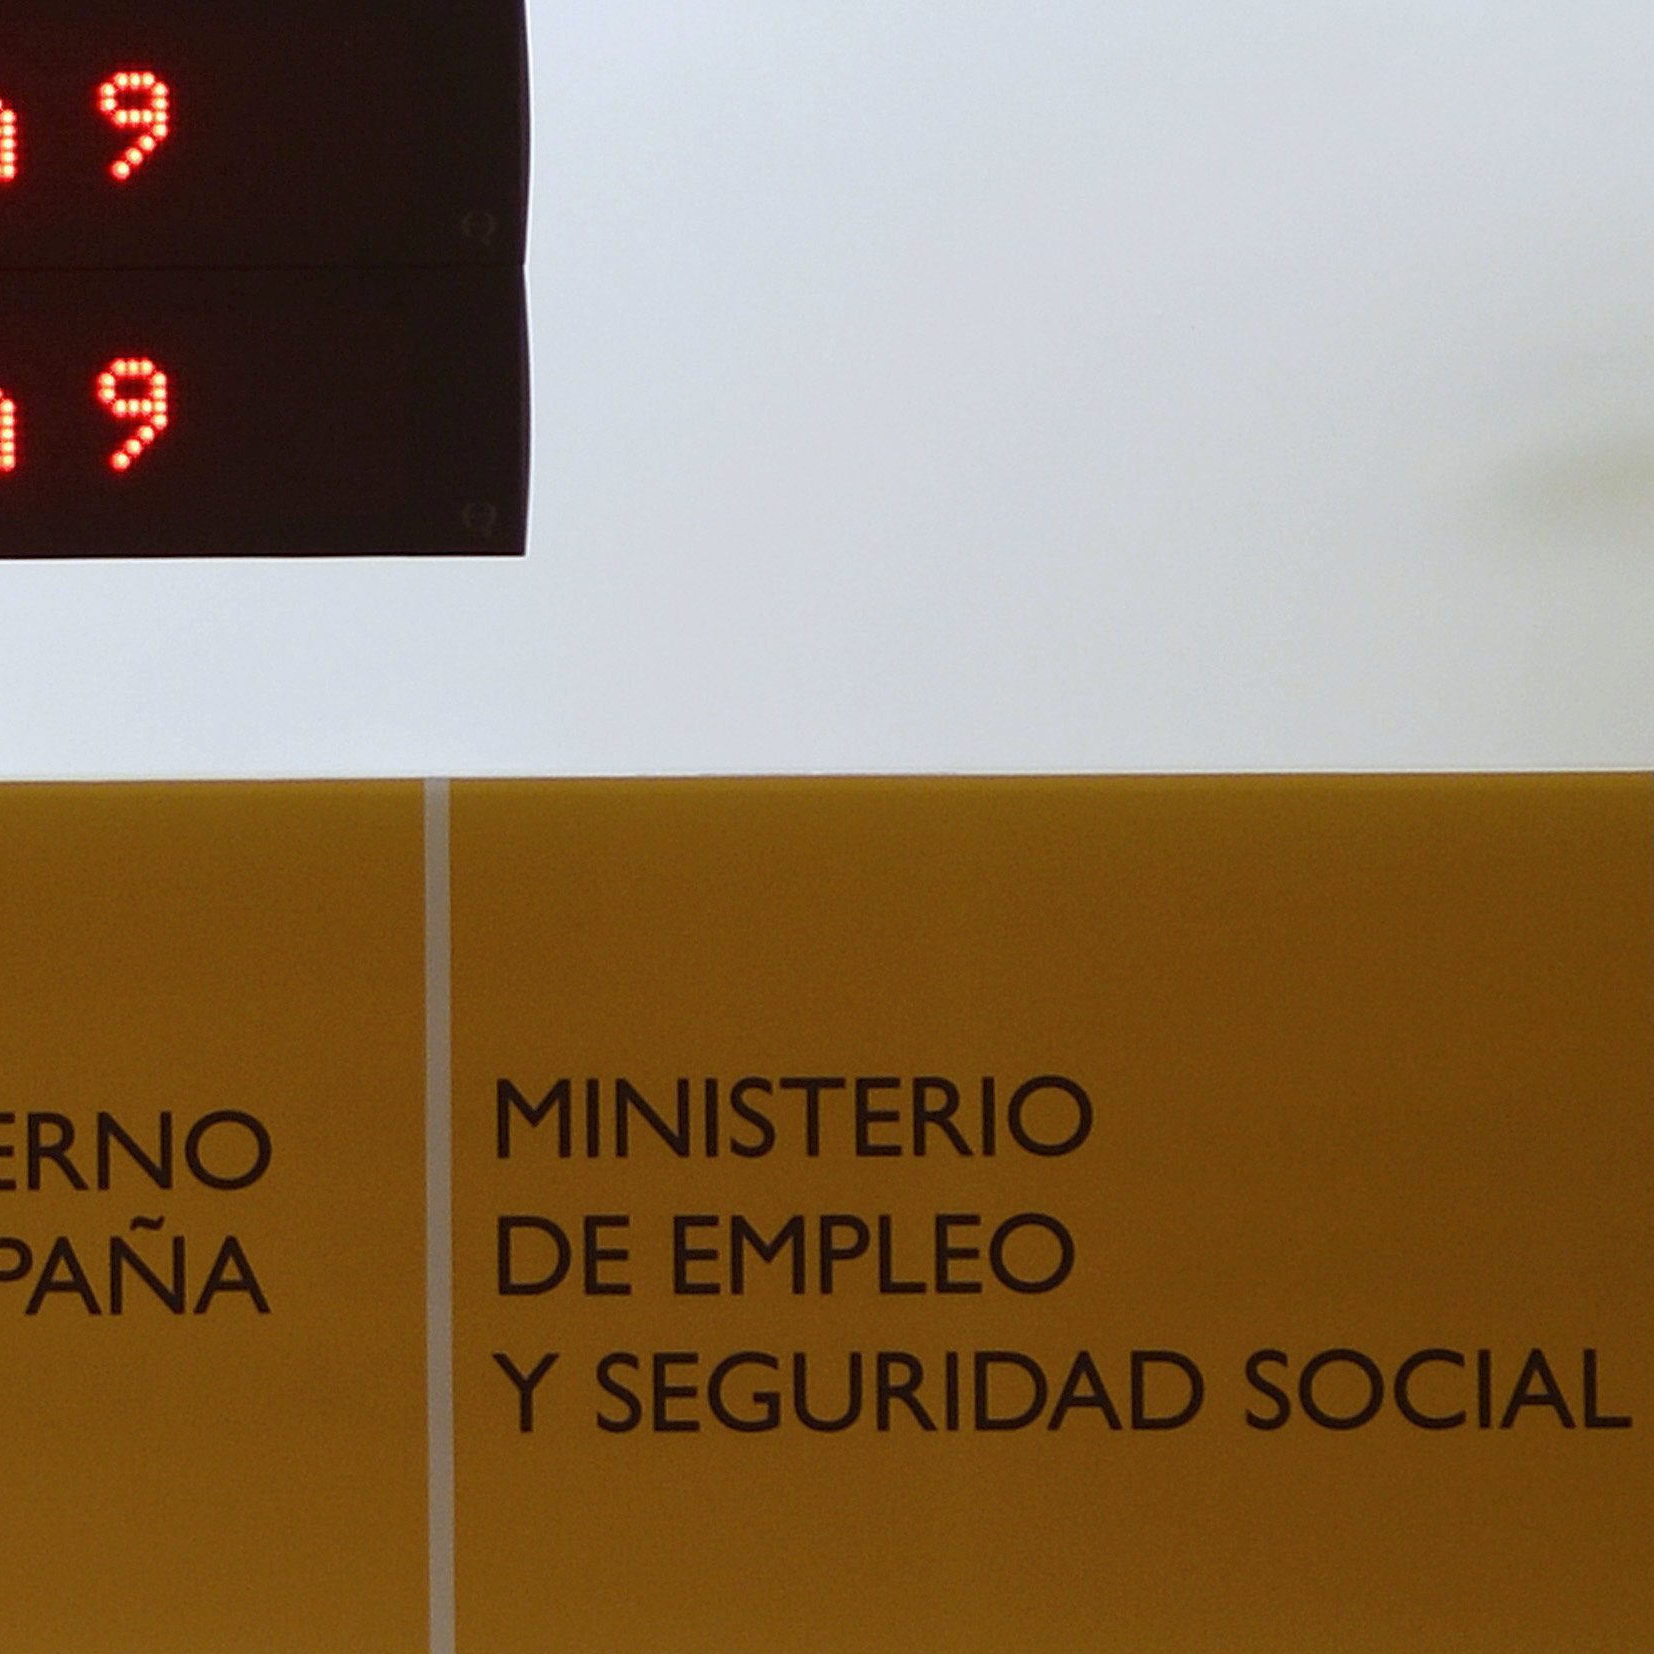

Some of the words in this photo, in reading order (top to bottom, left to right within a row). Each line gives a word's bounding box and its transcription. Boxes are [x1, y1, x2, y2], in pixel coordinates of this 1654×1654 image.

[97, 71, 170, 181] 9
[96, 357, 168, 471] 9
[497, 1076, 1092, 1158] MINISTERIO
[498, 1216, 631, 1295] DE
[674, 1213, 1074, 1295] EMPLEO
[493, 1354, 558, 1433] Y
[597, 1351, 1204, 1433] SEGURIDAD
[1246, 1349, 1632, 1430] SOCIAL
